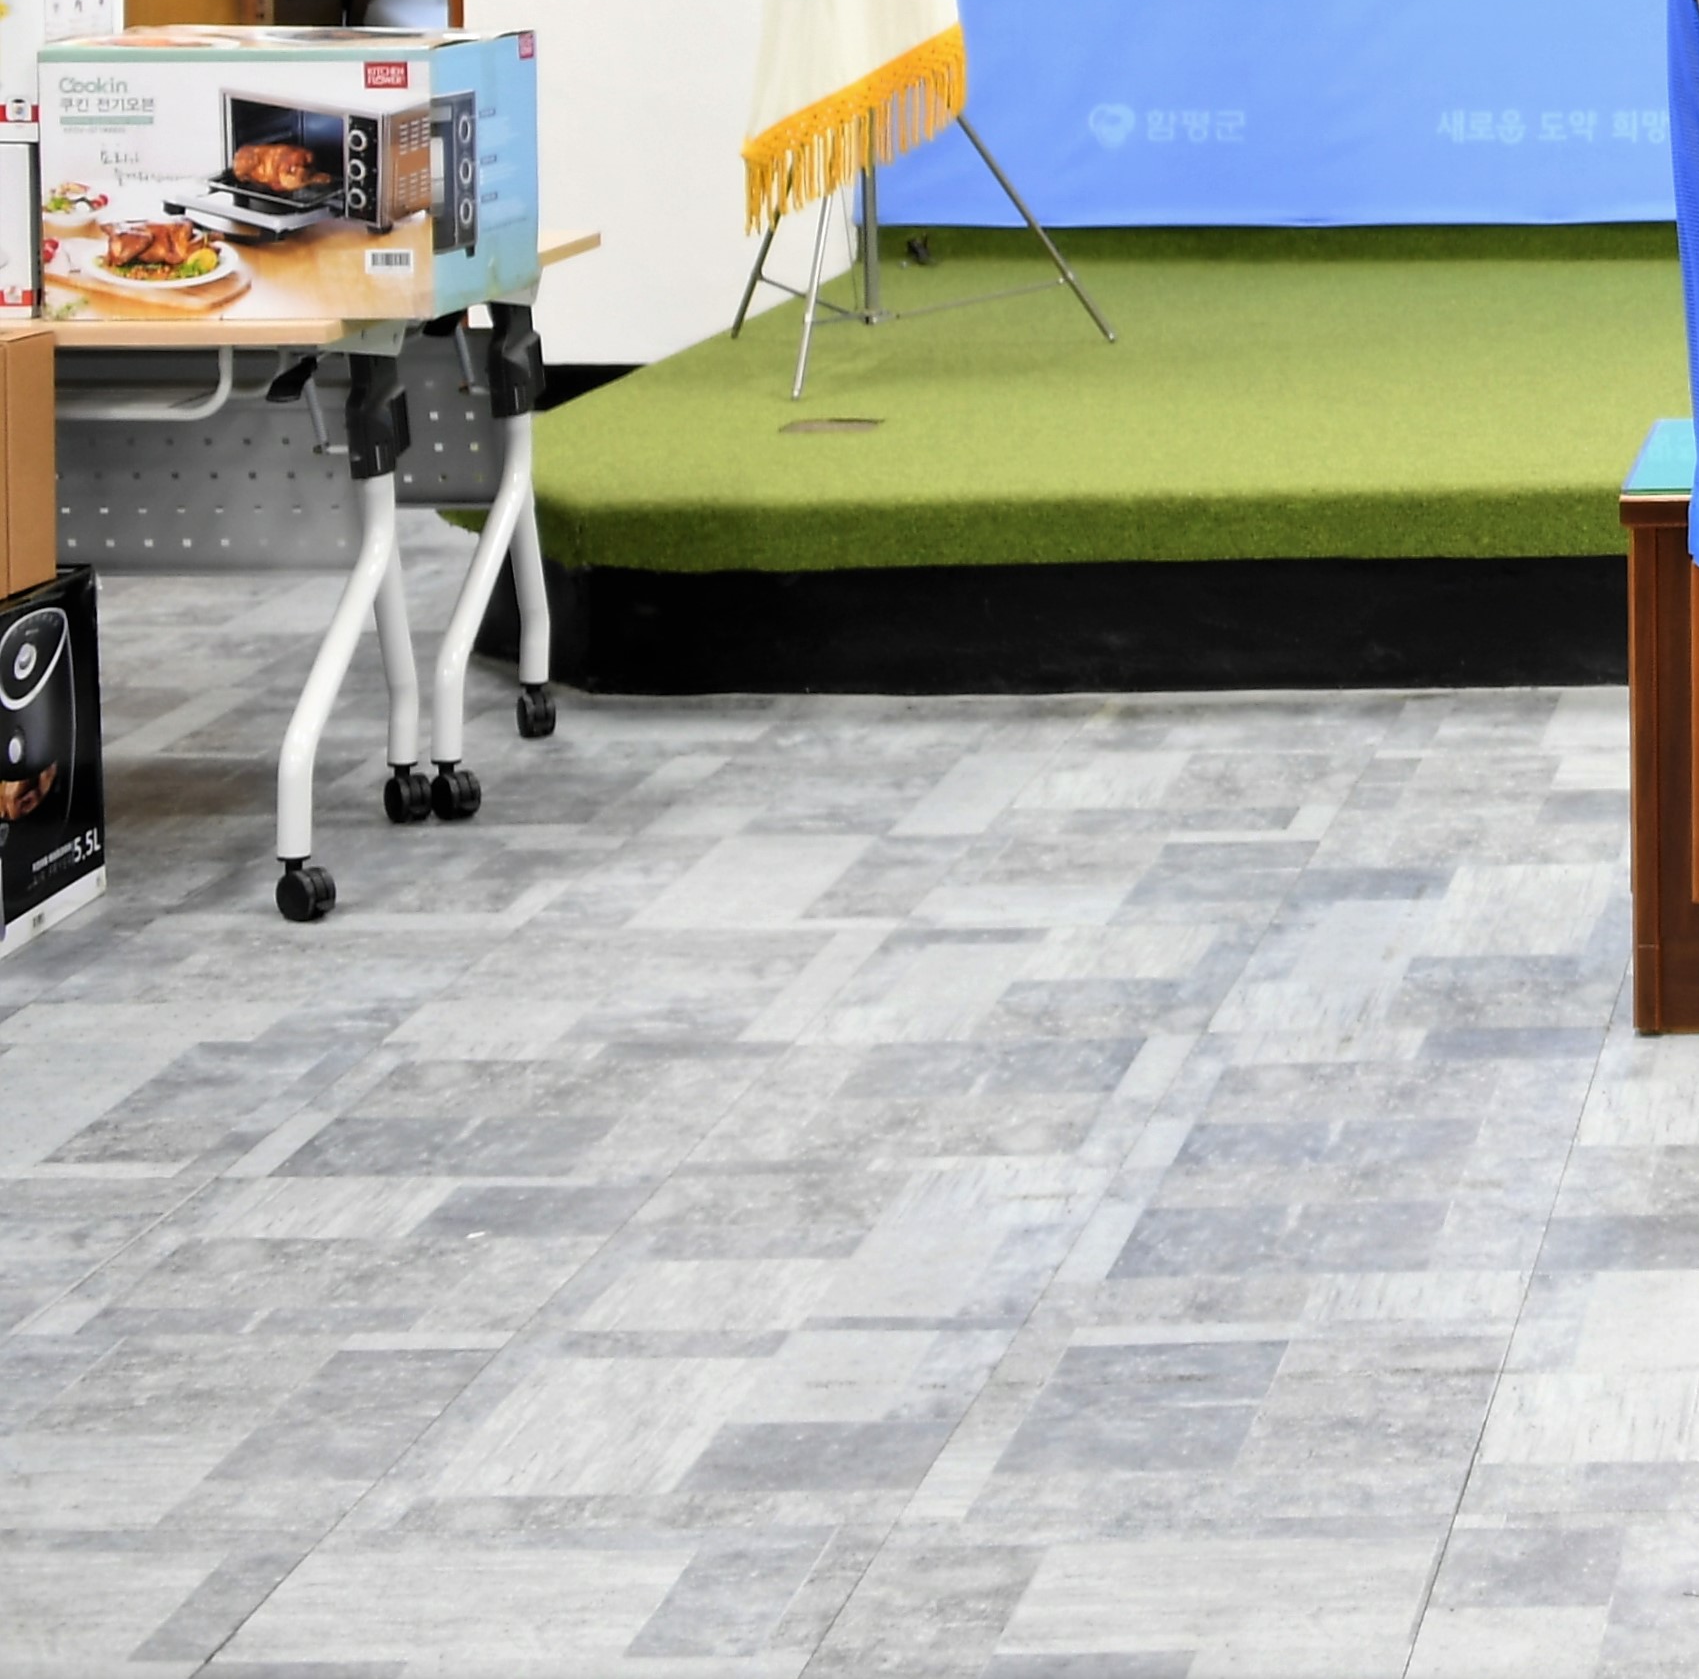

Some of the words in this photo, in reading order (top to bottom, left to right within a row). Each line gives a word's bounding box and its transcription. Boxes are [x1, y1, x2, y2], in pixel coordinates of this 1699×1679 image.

[58, 77, 128, 94] Cookin
[59, 97, 89, 113] 쿠킨
[96, 97, 155, 113] 전기오븐
[1146, 108, 1247, 145] 함평군
[1435, 108, 1526, 145] 새로운
[1537, 108, 1599, 144] 도약
[1611, 108, 1670, 145] 희망
[73, 827, 101, 863] 5.5L
